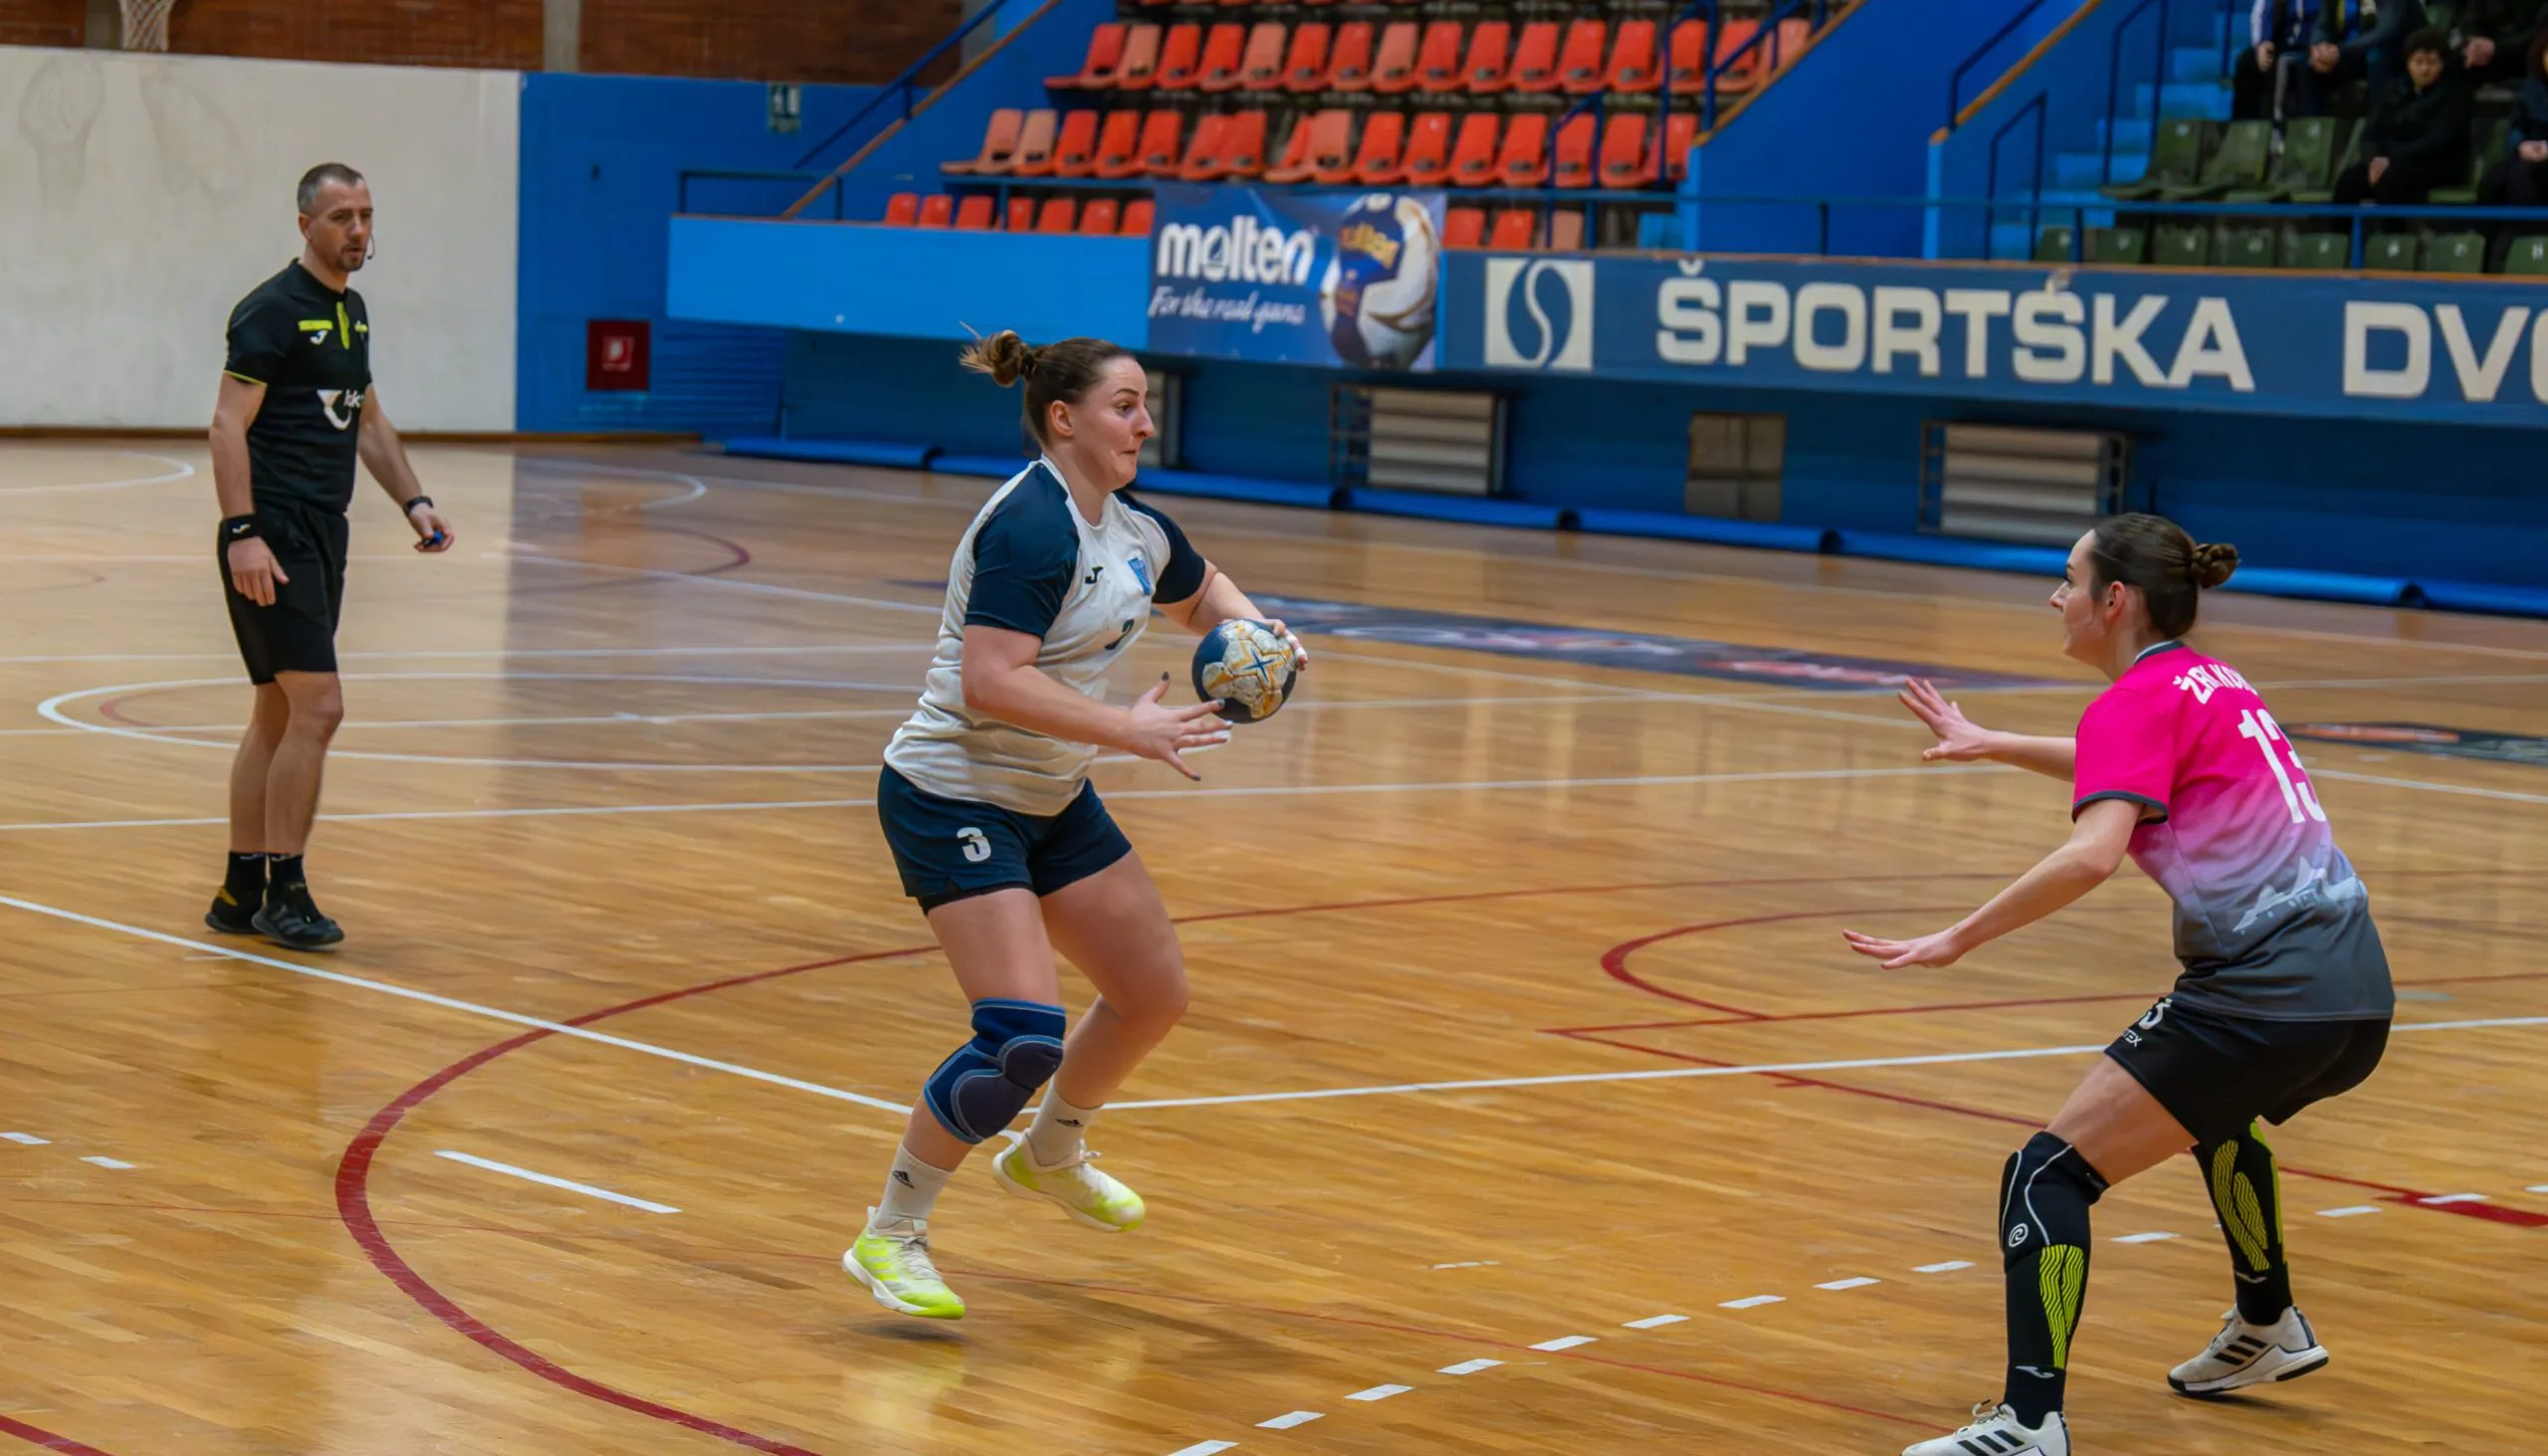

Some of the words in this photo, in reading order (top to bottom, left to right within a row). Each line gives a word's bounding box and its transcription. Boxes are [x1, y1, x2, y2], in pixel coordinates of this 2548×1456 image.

[1157, 215, 1315, 285] molten
[2343, 301, 2548, 405] DV
[2237, 709, 2327, 824] 13
[956, 827, 991, 862] 3
